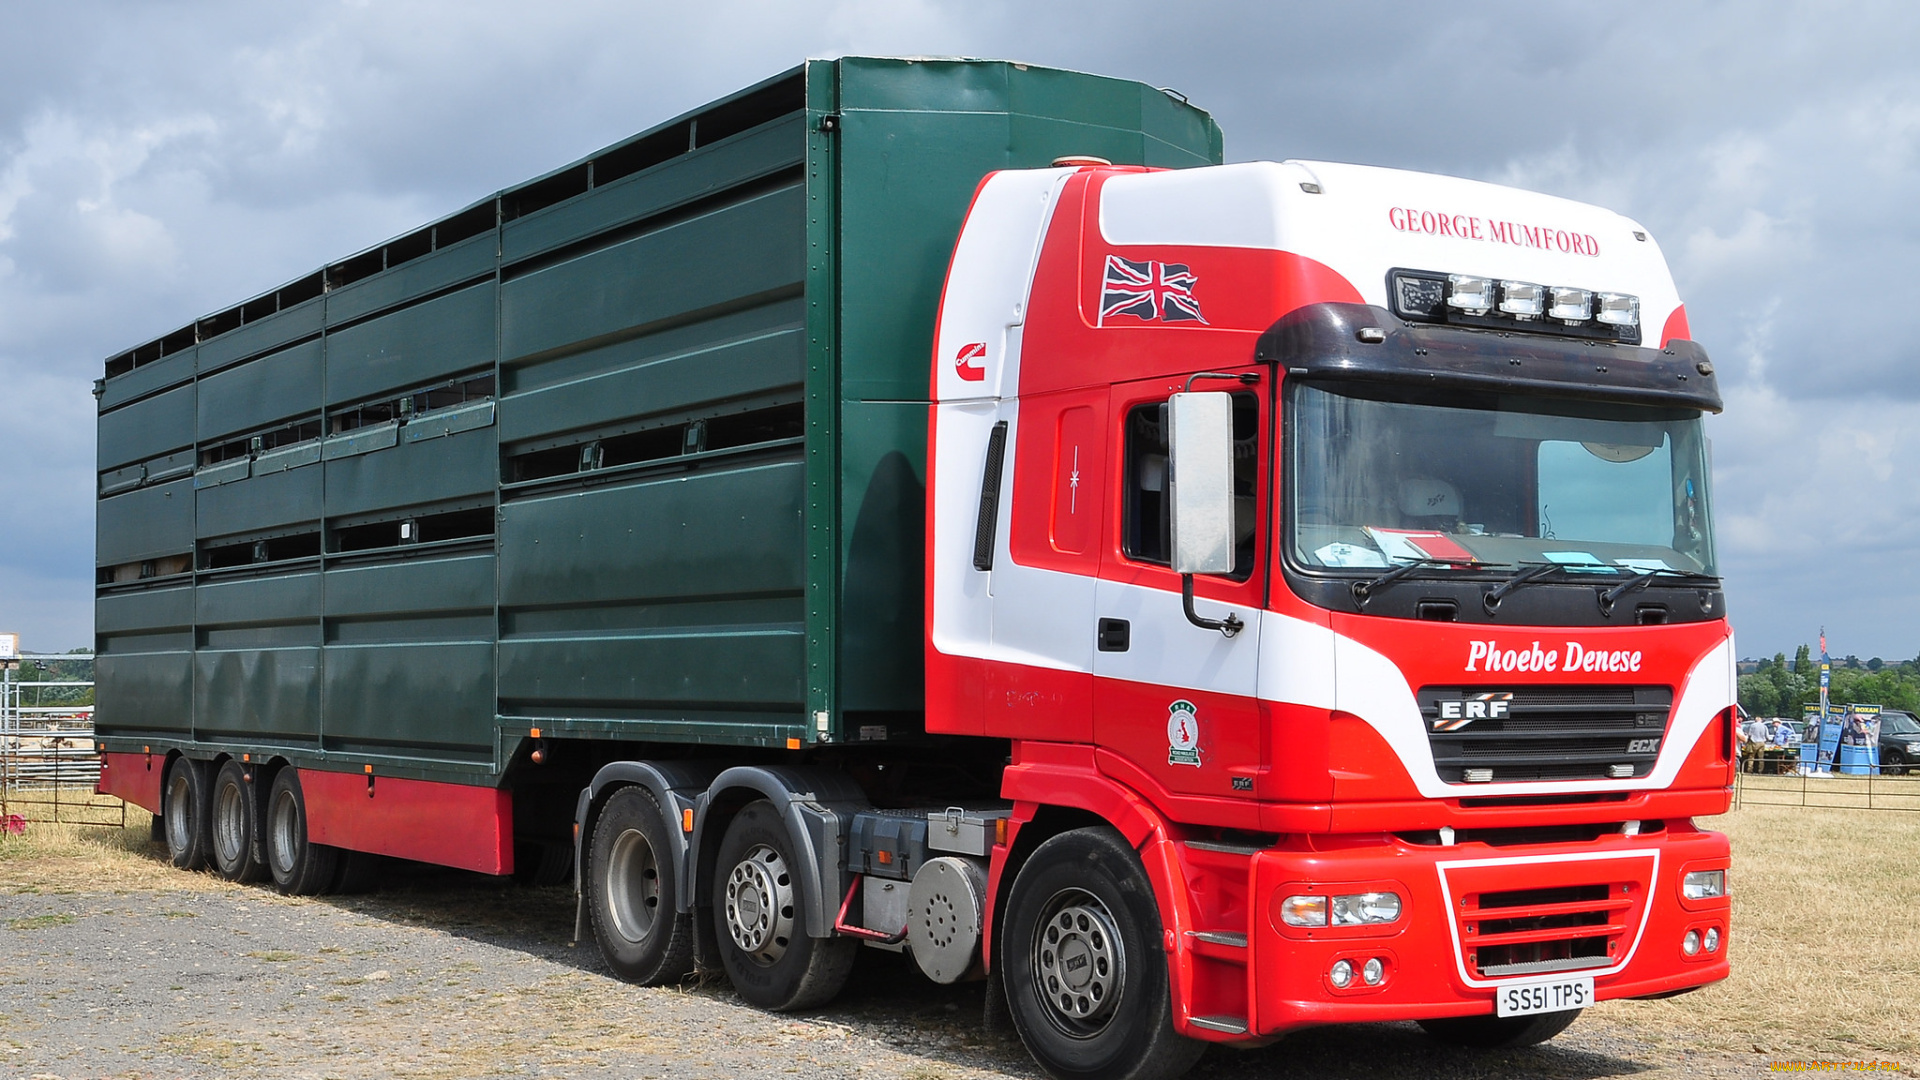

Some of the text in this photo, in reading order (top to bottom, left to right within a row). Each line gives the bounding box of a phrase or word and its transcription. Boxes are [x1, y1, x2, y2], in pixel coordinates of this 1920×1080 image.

[1389, 207, 1600, 257] GEORGE MUMFORD
[955, 342, 985, 367] Cummins
[1464, 640, 1642, 672] Phoebe Denese
[1441, 701, 1509, 718] ERF
[1627, 739, 1660, 753] ECX
[1508, 983, 1584, 1011] SS51 TPS
